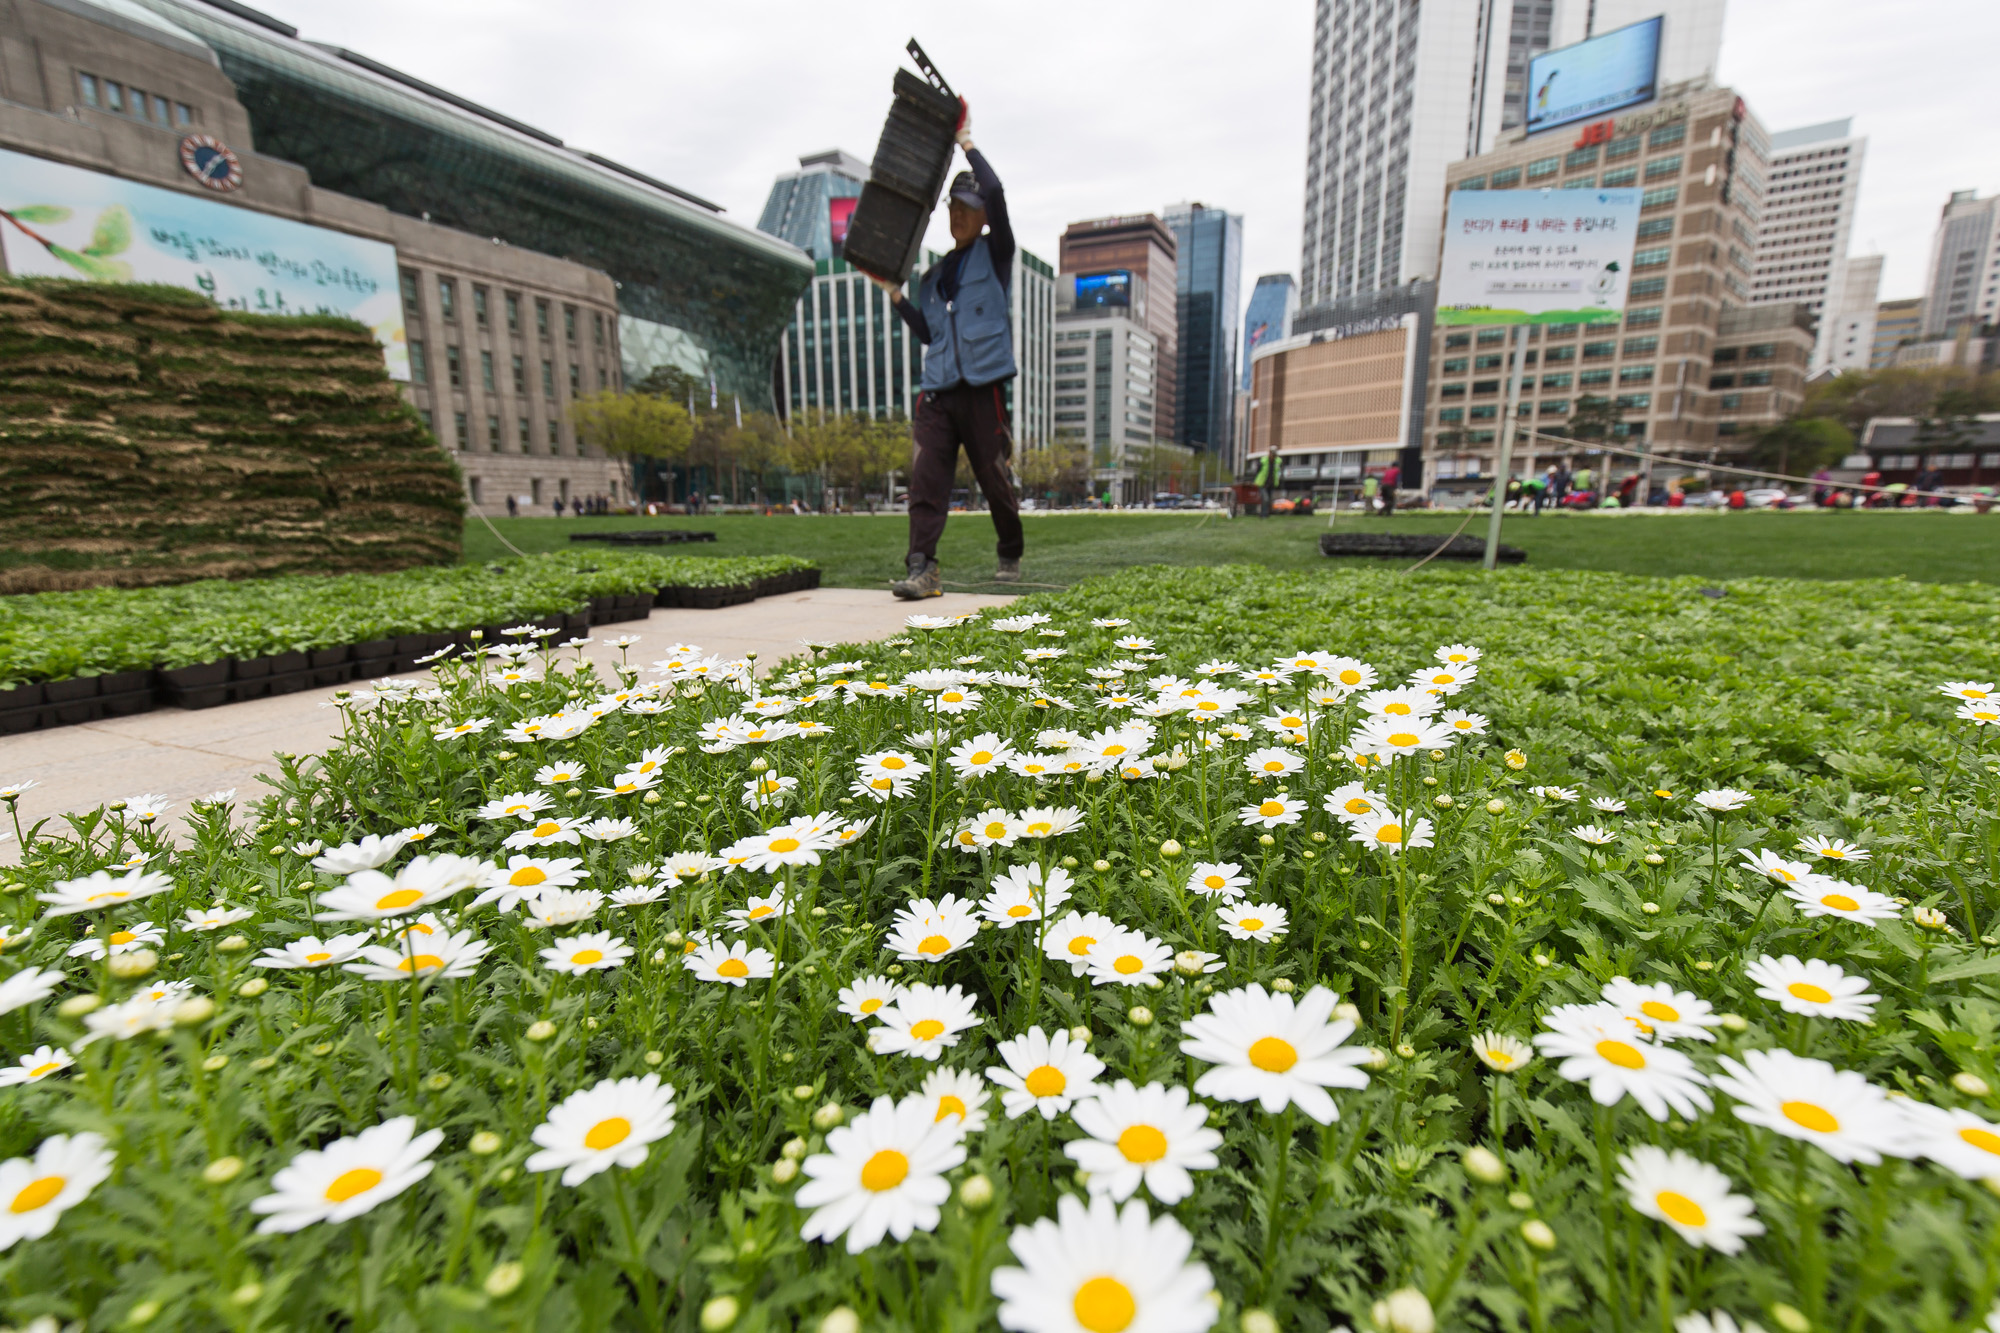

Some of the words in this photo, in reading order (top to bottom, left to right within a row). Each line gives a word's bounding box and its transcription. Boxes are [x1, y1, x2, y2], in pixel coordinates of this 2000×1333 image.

[1574, 118, 1615, 149] JEI
[1463, 217, 1494, 234] 잔디가
[1499, 217, 1531, 233] 뿌리를
[1535, 217, 1567, 233] 내리는
